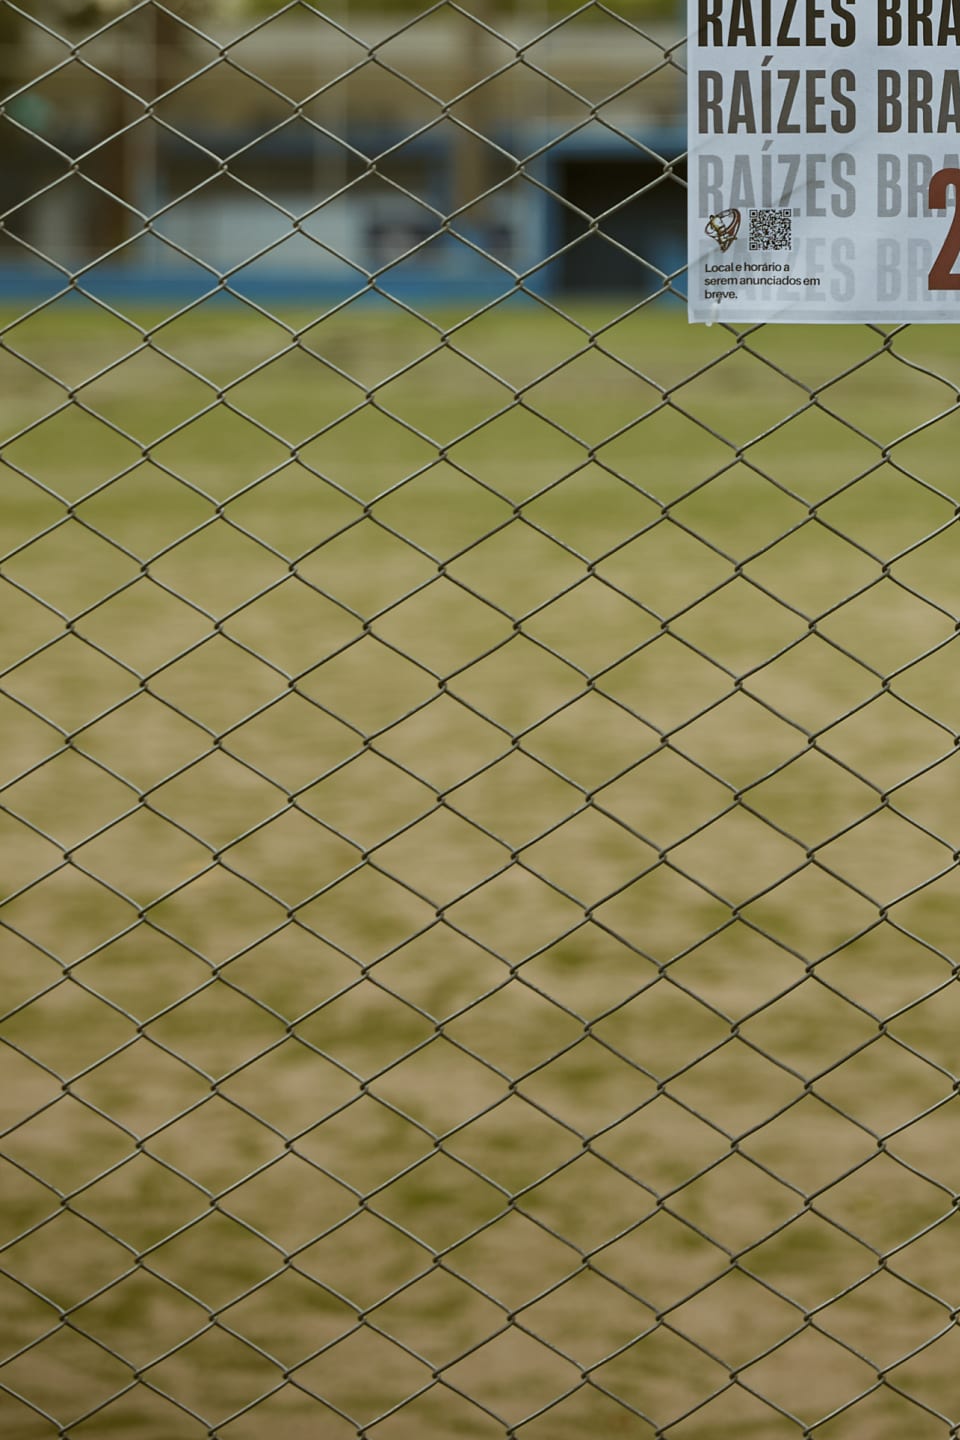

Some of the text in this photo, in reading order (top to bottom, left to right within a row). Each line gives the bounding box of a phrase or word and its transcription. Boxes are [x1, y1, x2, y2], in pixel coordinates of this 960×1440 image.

[698, 56, 857, 135] RAÍZES
[698, 140, 857, 219] RAÍZES
[705, 261, 790, 273] Local e horário a
[704, 275, 821, 286] serem anunciados em
[704, 289, 738, 300] breve.
